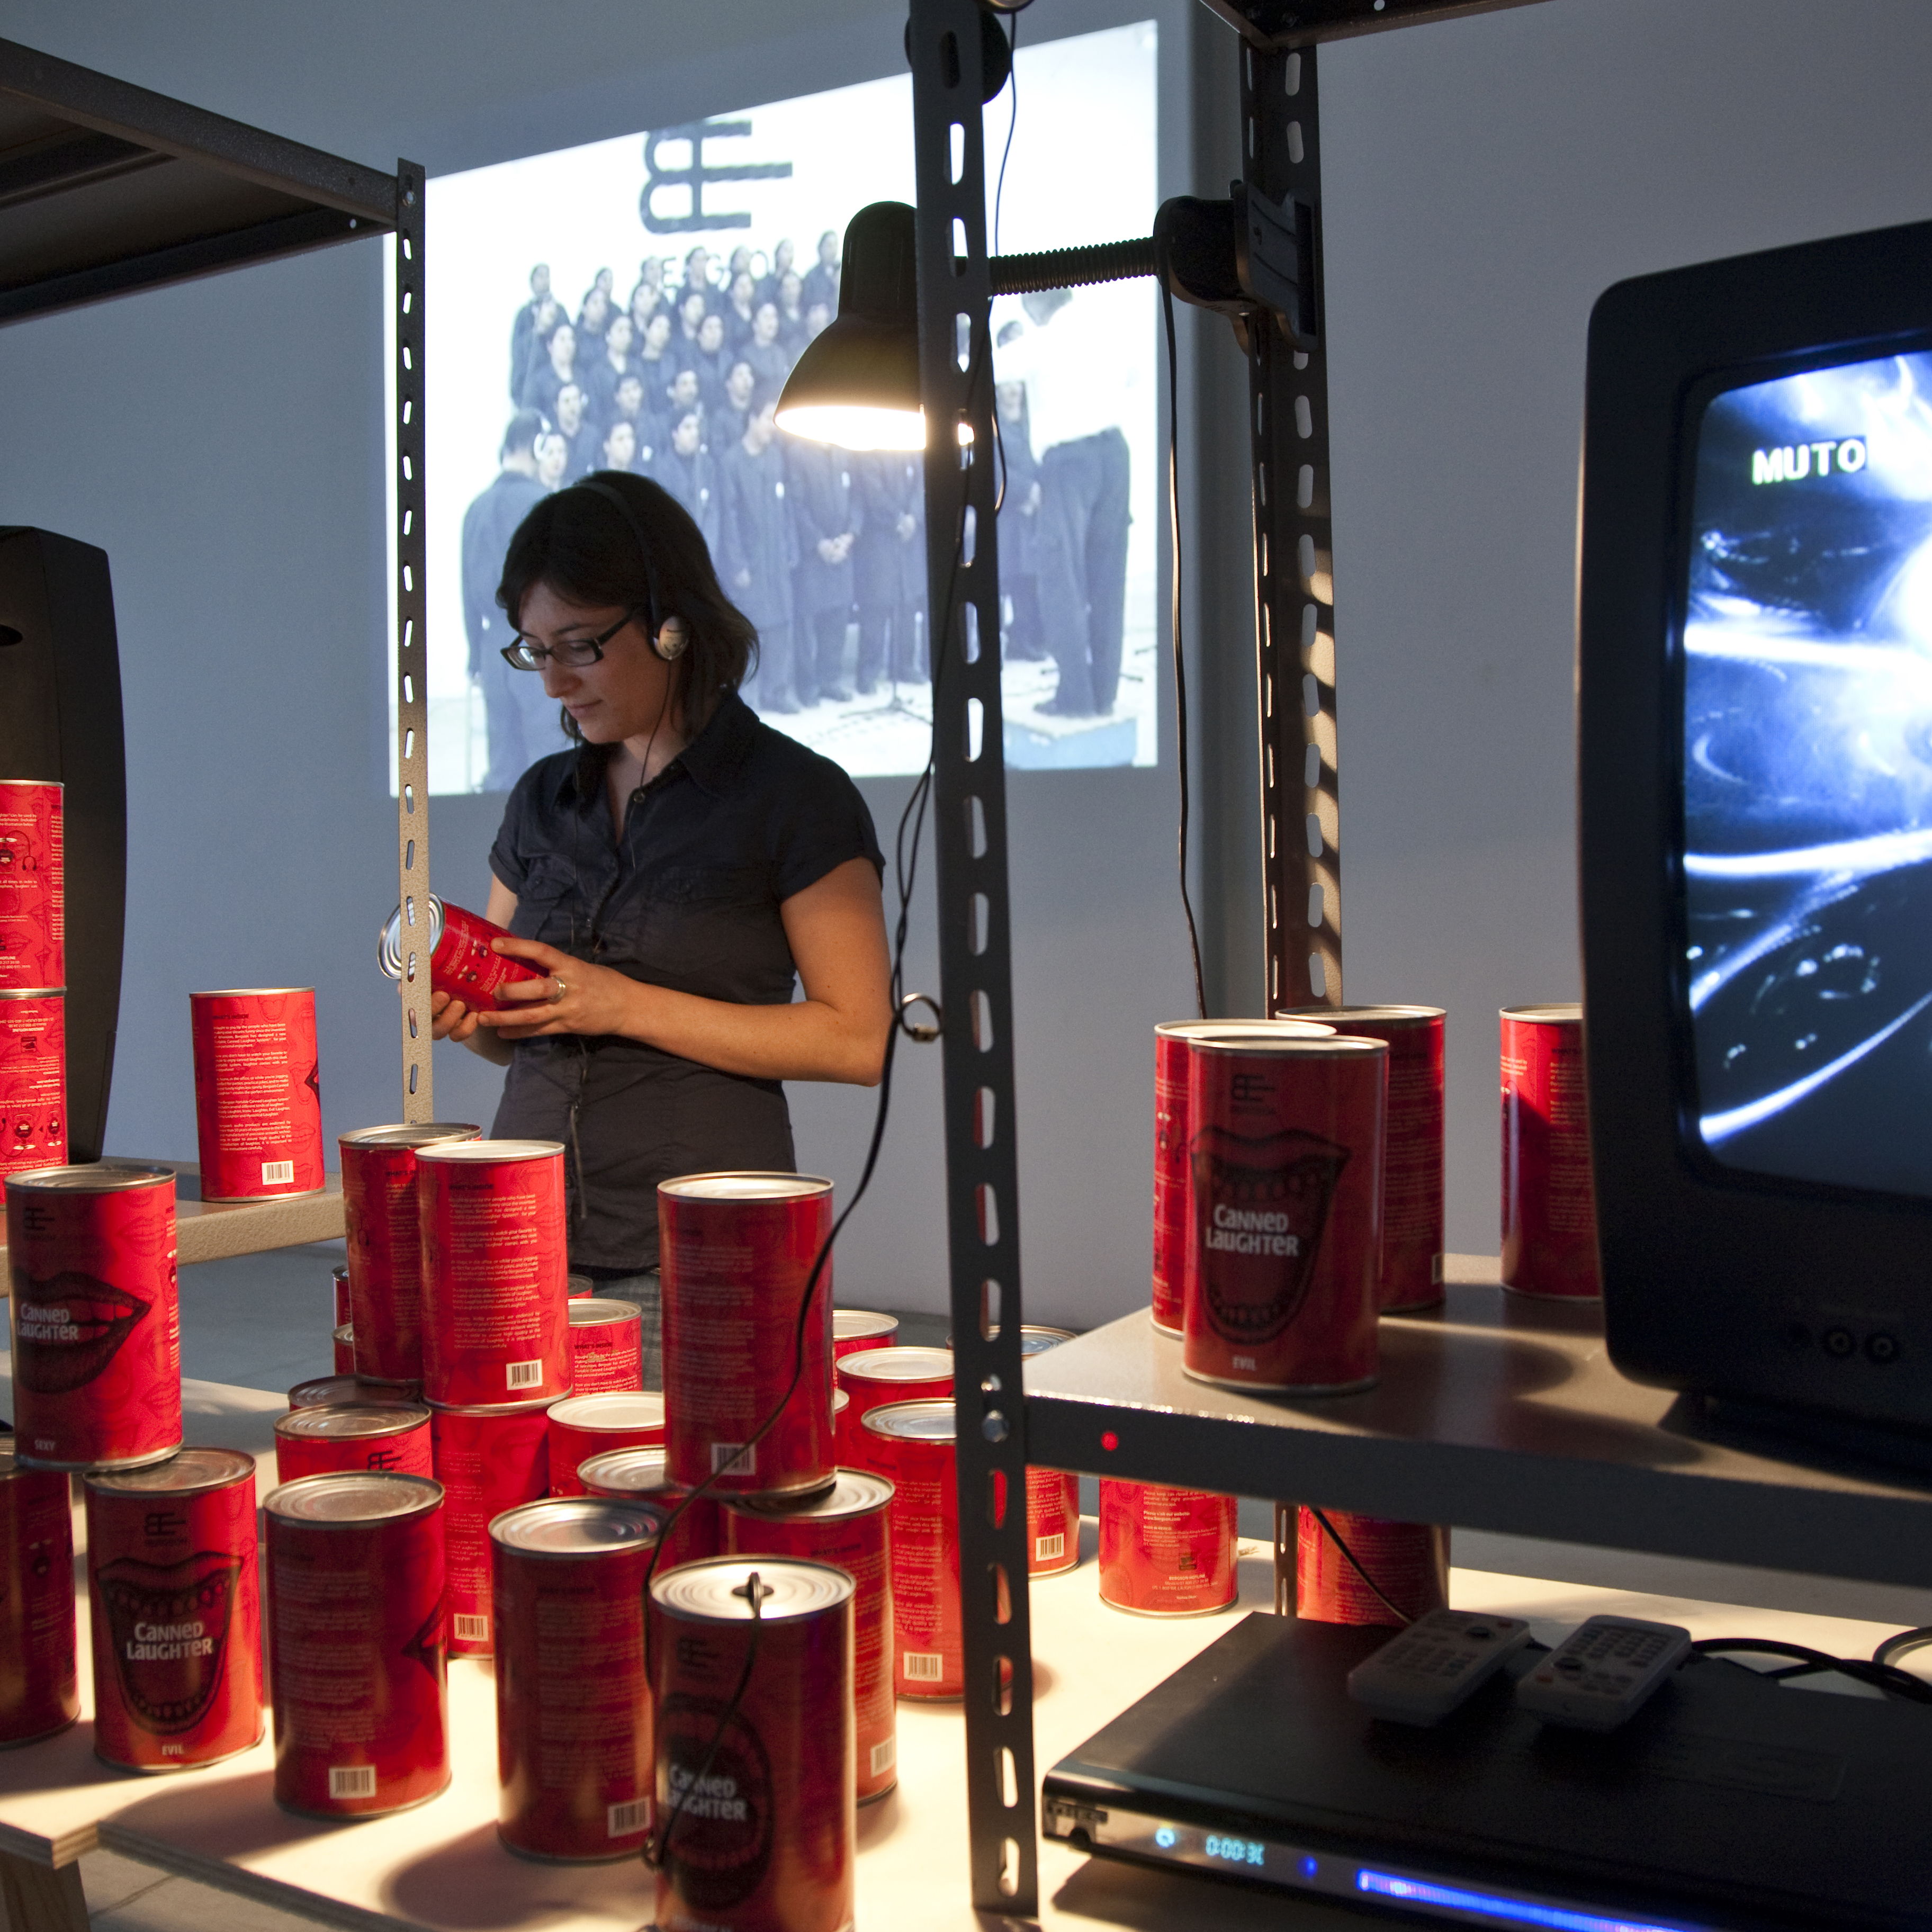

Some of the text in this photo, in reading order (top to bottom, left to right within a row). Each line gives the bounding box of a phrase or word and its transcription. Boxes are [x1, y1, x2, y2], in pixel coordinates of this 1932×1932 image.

[1752, 437, 1866, 486] MUTO
[1233, 1355, 1256, 1370] EVIL
[34, 1440, 55, 1451] SEXY
[161, 1744, 183, 1756] EVIL
